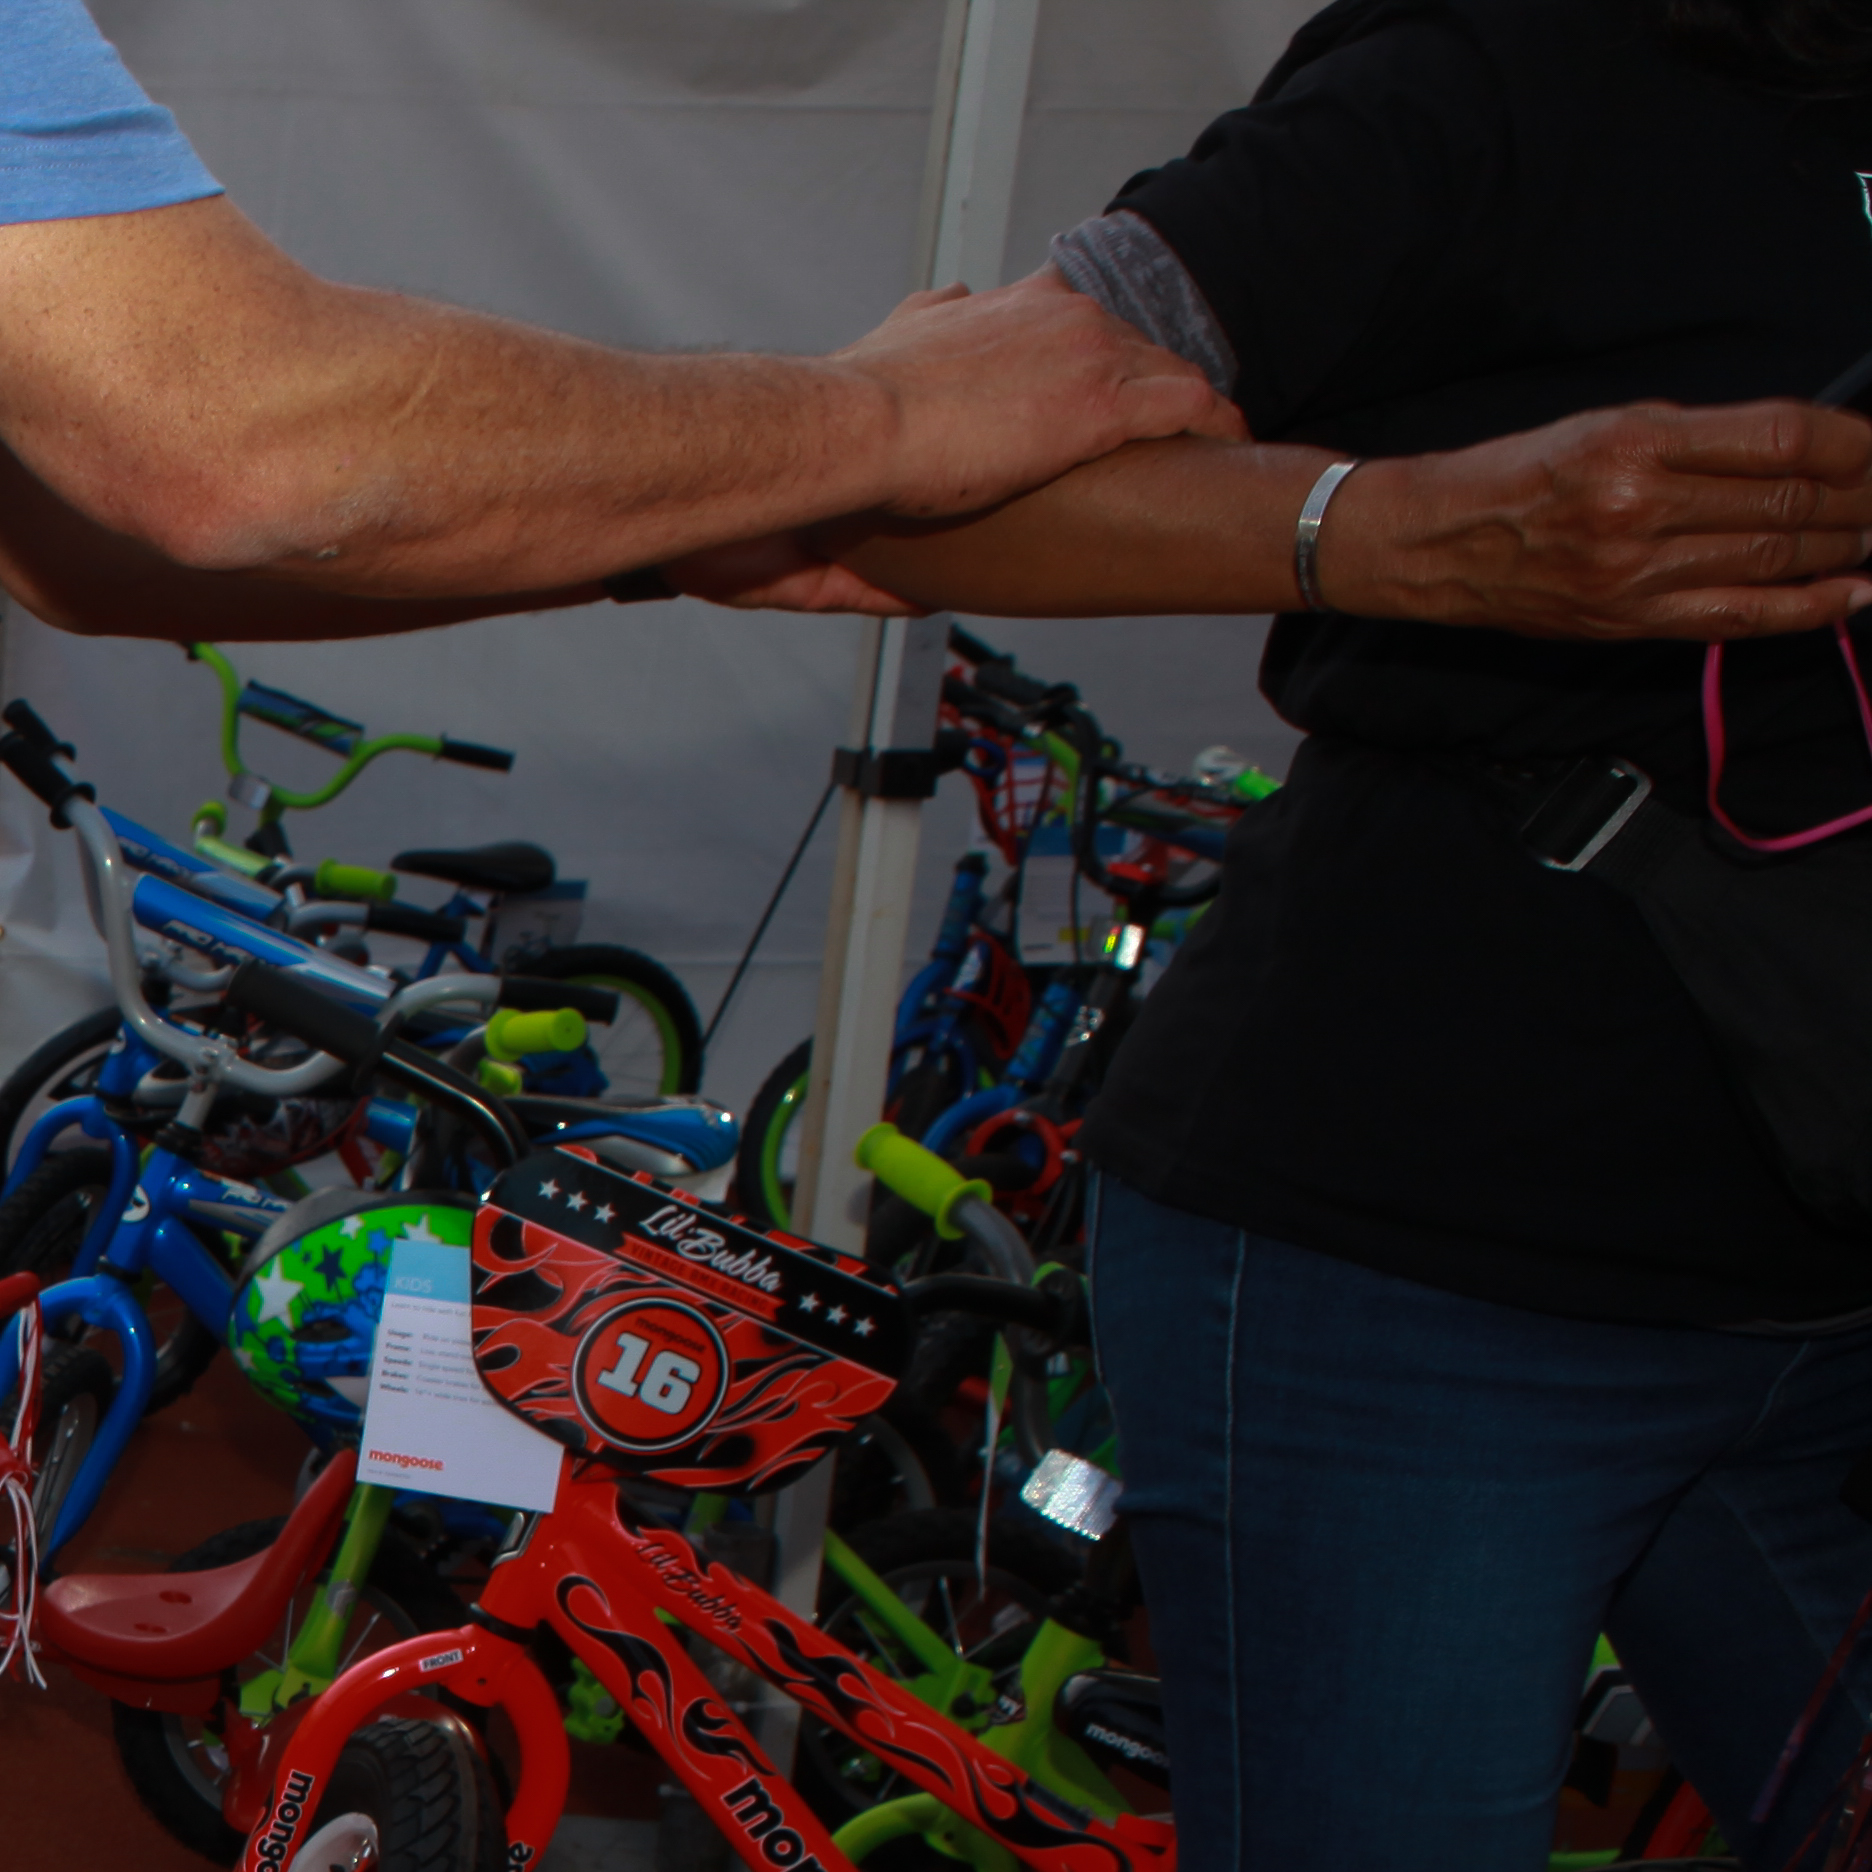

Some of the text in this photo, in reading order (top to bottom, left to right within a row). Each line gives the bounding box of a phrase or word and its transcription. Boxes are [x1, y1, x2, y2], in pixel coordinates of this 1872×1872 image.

[394, 1276, 433, 1293] KIDS
[634, 1316, 706, 1353] mongoose
[597, 1332, 701, 1416] 16
[368, 1449, 445, 1471] mongoose
[422, 1651, 462, 1671] FRONT
